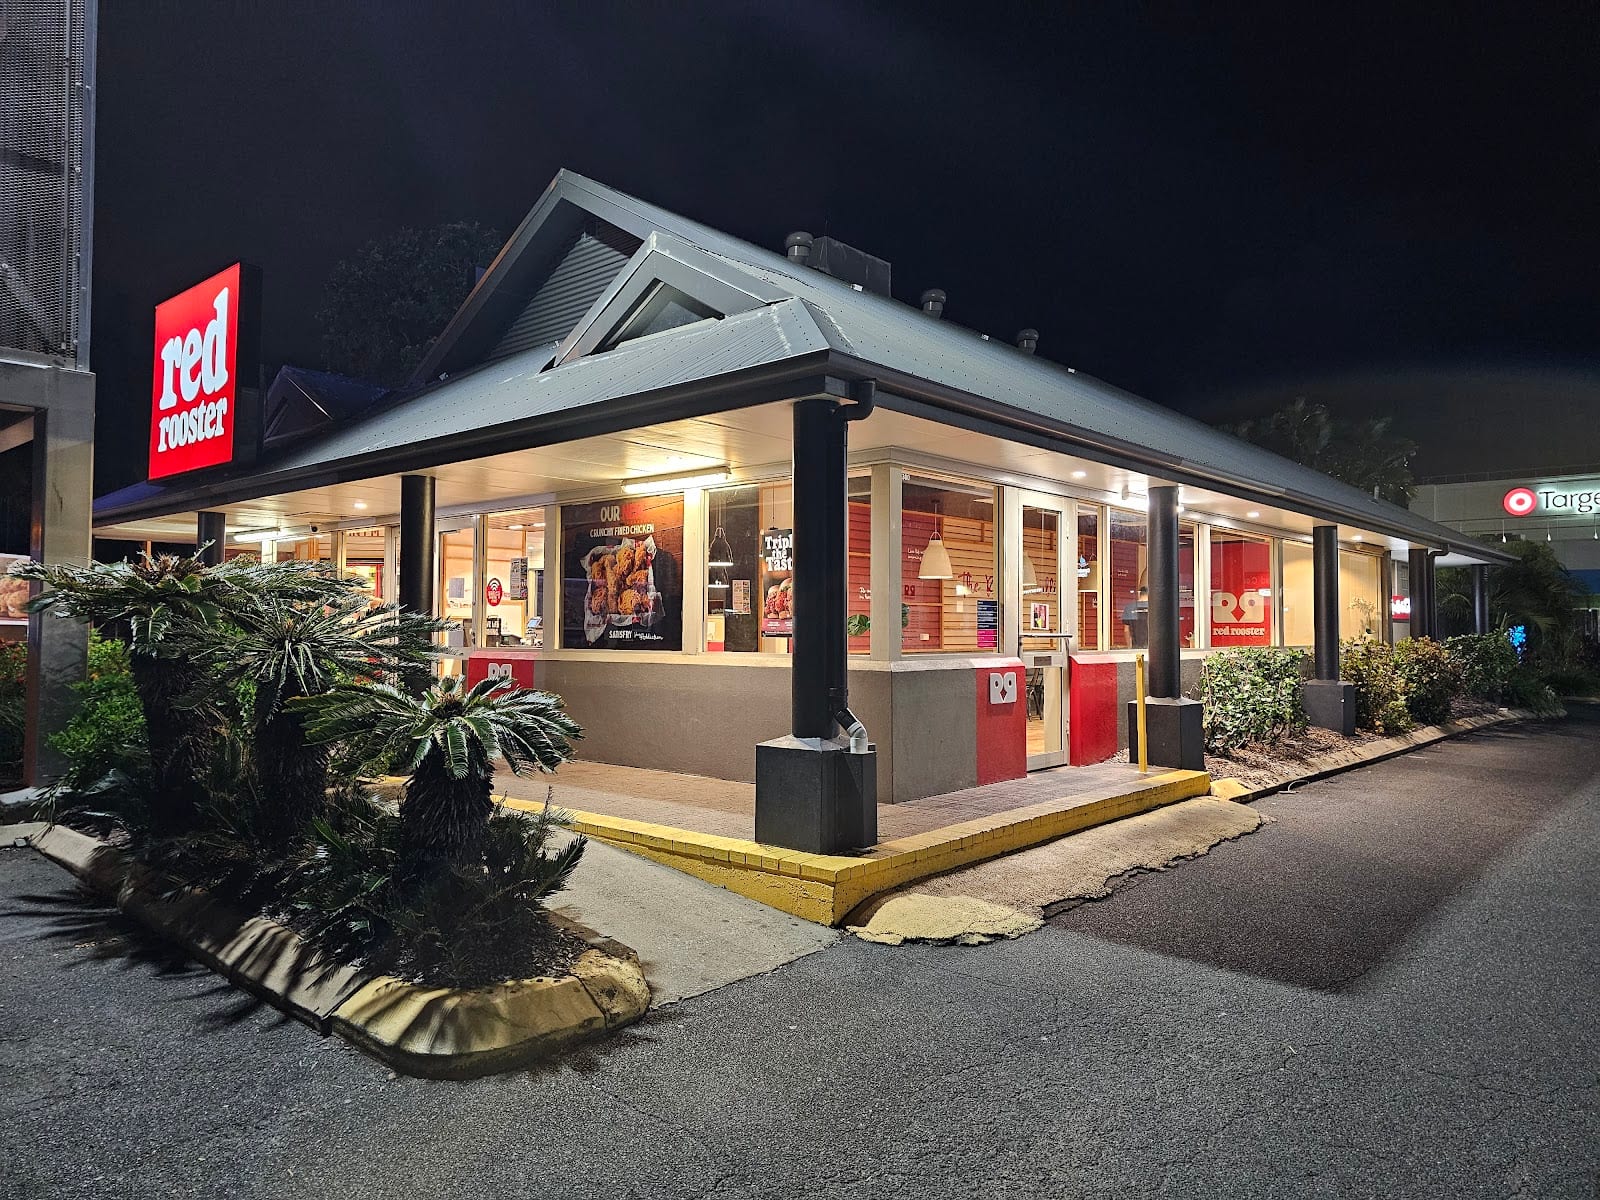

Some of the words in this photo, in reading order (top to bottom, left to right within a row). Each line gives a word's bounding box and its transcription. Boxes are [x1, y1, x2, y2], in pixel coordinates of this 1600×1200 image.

[159, 287, 229, 410] red
[157, 397, 228, 452] rooster
[600, 505, 620, 523] OUR
[589, 527, 614, 538] CRUNCHY
[614, 525, 630, 536] FRIED
[630, 523, 655, 535] CHICKEN
[771, 548, 788, 560] the
[958, 571, 984, 594] the
[1212, 625, 1230, 636] red
[1230, 627, 1265, 636] rooster
